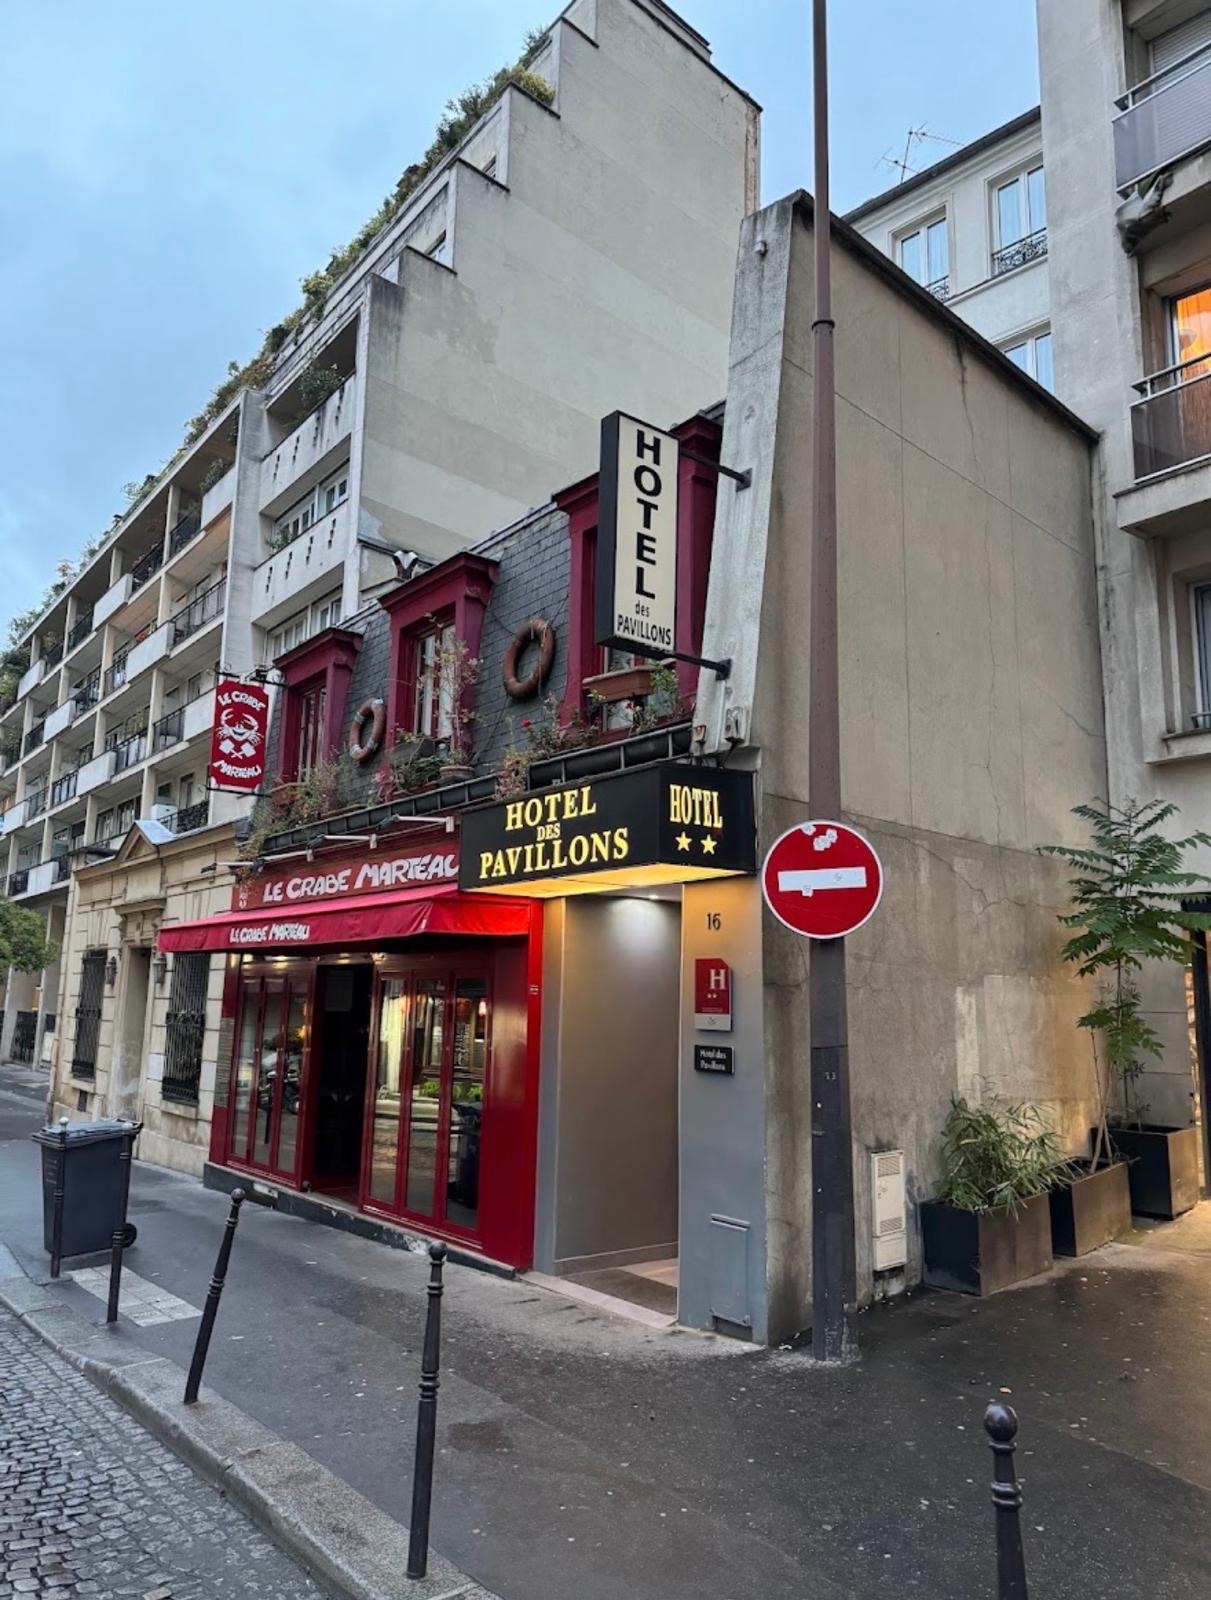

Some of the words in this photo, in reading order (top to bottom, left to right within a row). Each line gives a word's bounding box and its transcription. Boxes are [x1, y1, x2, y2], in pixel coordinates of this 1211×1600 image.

[634, 428, 662, 600] HOTEL
[635, 600, 650, 617] des
[617, 614, 671, 645] PAVILLONS
[218, 692, 232, 706] LE
[231, 691, 266, 711] CRABE
[212, 760, 262, 778] MARTEAU
[505, 785, 597, 831] HOTEL
[669, 784, 723, 829] HOTEL
[536, 822, 561, 842] DES
[479, 827, 629, 879] PAVILLONS
[263, 881, 283, 903] LE
[286, 868, 351, 898] CRABE
[706, 912, 721, 931] 16
[240, 925, 269, 943] CRABE
[268, 922, 310, 941] MARTEAU
[710, 969, 726, 990] H
